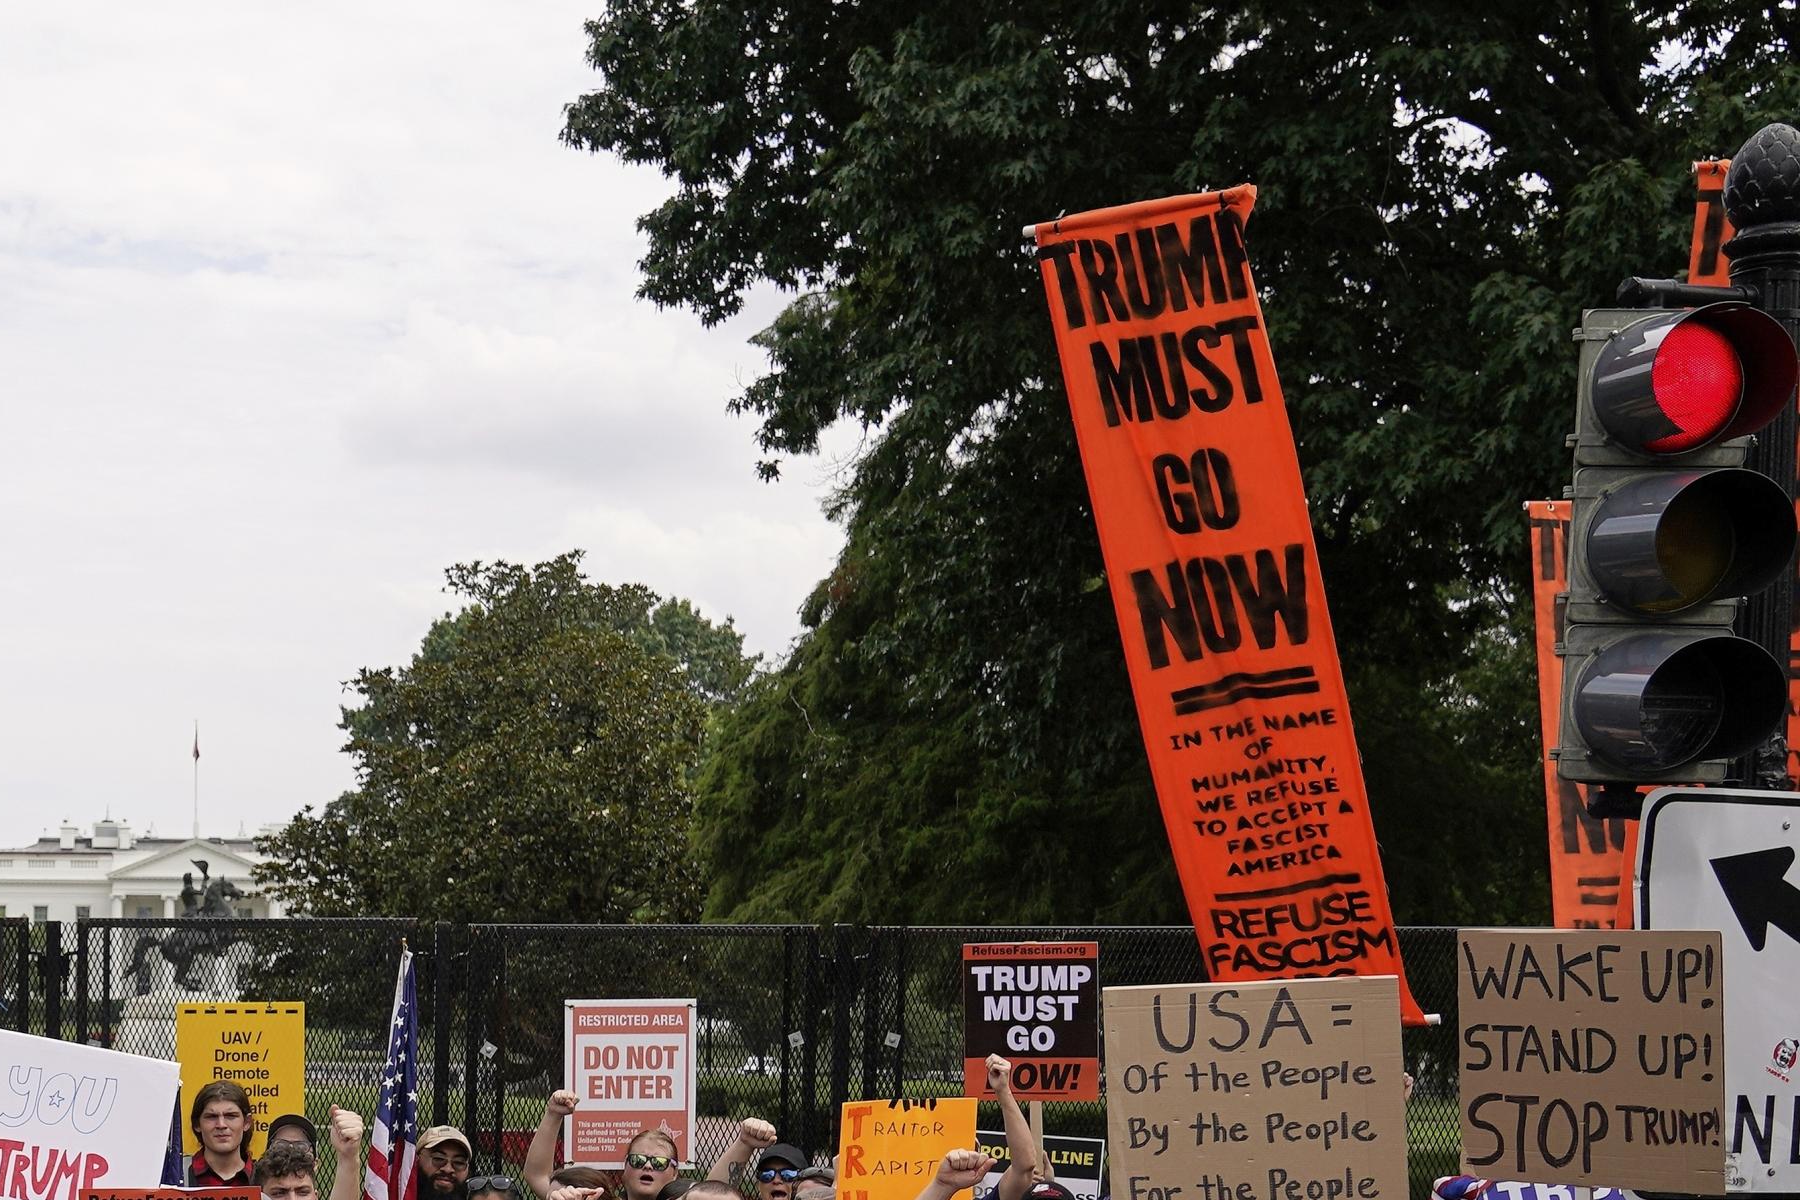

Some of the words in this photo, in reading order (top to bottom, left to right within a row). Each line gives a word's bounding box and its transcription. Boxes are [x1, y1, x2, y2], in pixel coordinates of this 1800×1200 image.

[1090, 315, 1264, 428] MUST
[1152, 446, 1241, 535] GO
[1130, 542, 1310, 671] NOW
[1227, 824, 1329, 855] FASCIST
[1227, 844, 1342, 877] AMERICA
[1209, 891, 1375, 940] REFUSE
[972, 945, 1086, 956] RefuseFascism.org
[1207, 927, 1395, 976] FASCISM
[971, 965, 1091, 992] TRUMP
[1463, 942, 1620, 1002] WAKE
[1641, 945, 1714, 1009] UP!
[578, 1014, 649, 1026] RESTRICTED
[652, 1014, 683, 1026] AREA
[984, 995, 1079, 1022] MUST
[1151, 986, 1314, 1054] USA
[221, 1032, 251, 1044] UAV
[1006, 1025, 1056, 1052] GO
[1464, 1023, 1617, 1074] STAND
[1638, 1033, 1714, 1082] UP!
[215, 1050, 258, 1062] Drone
[584, 1045, 619, 1070] DO
[626, 1045, 679, 1070] NOT
[213, 1067, 269, 1079] Remote
[588, 1075, 673, 1099] ENTER
[1124, 1060, 1170, 1094] Of
[1184, 1059, 1250, 1094] the
[1261, 1059, 1376, 1100] People
[1128, 1117, 1168, 1156] By
[1190, 1110, 1250, 1144] the
[1266, 1112, 1377, 1150] People
[1466, 1093, 1609, 1174] STOP
[1615, 1104, 1720, 1147] TRUMP!
[1051, 1151, 1094, 1166] LINE
